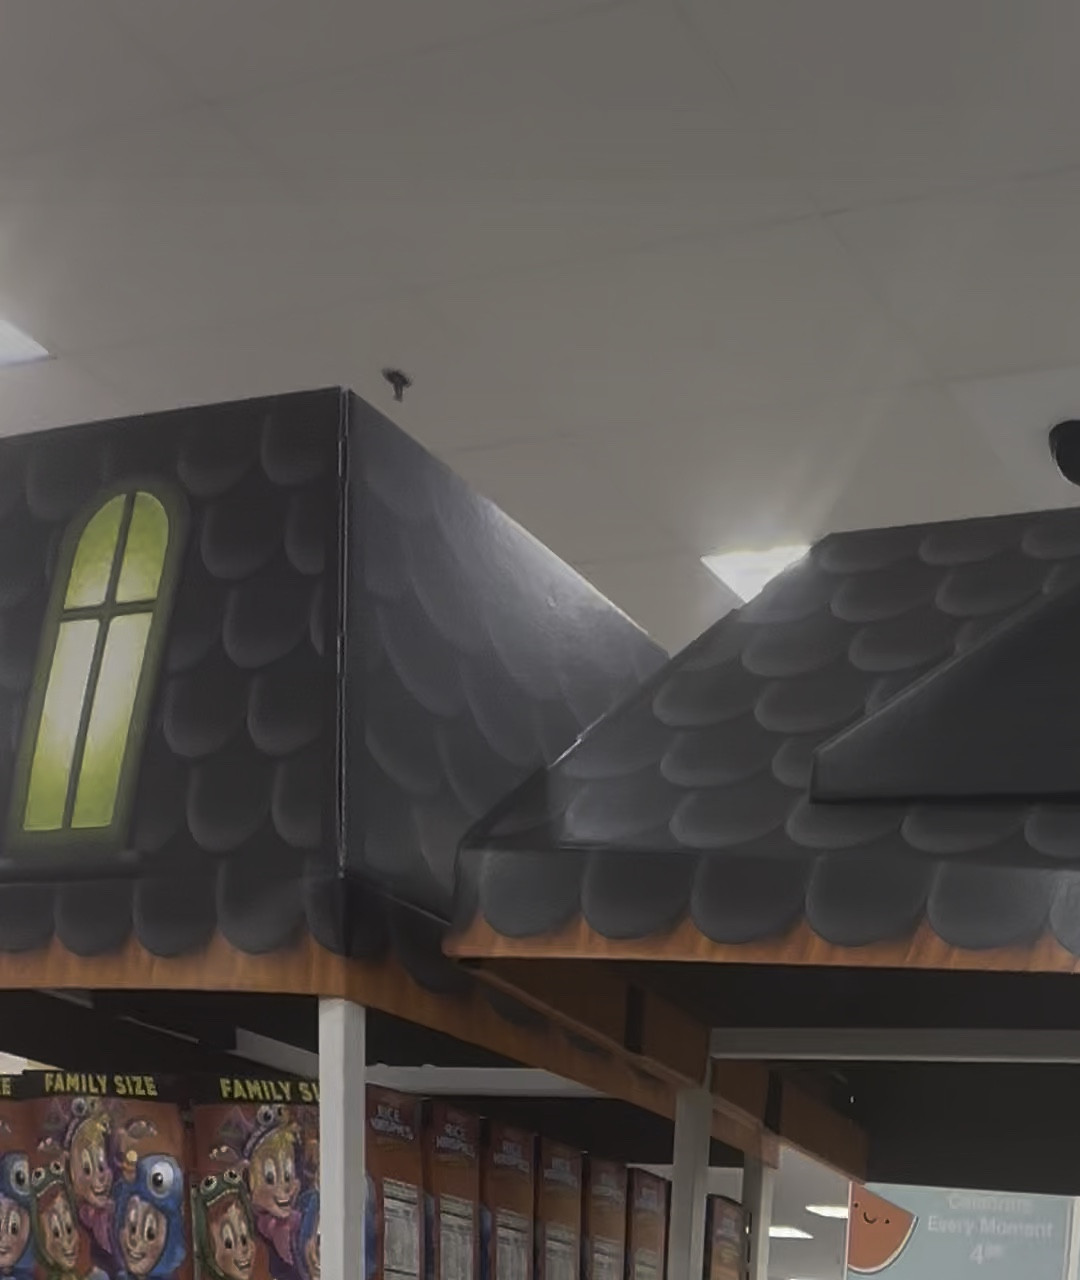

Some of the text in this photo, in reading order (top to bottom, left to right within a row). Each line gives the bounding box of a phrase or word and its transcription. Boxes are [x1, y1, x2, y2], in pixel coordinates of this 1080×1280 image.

[45, 1073, 158, 1096] FAMILY SIZE
[220, 1077, 320, 1102] FAMILY SI
[928, 1215, 974, 1236] Every
